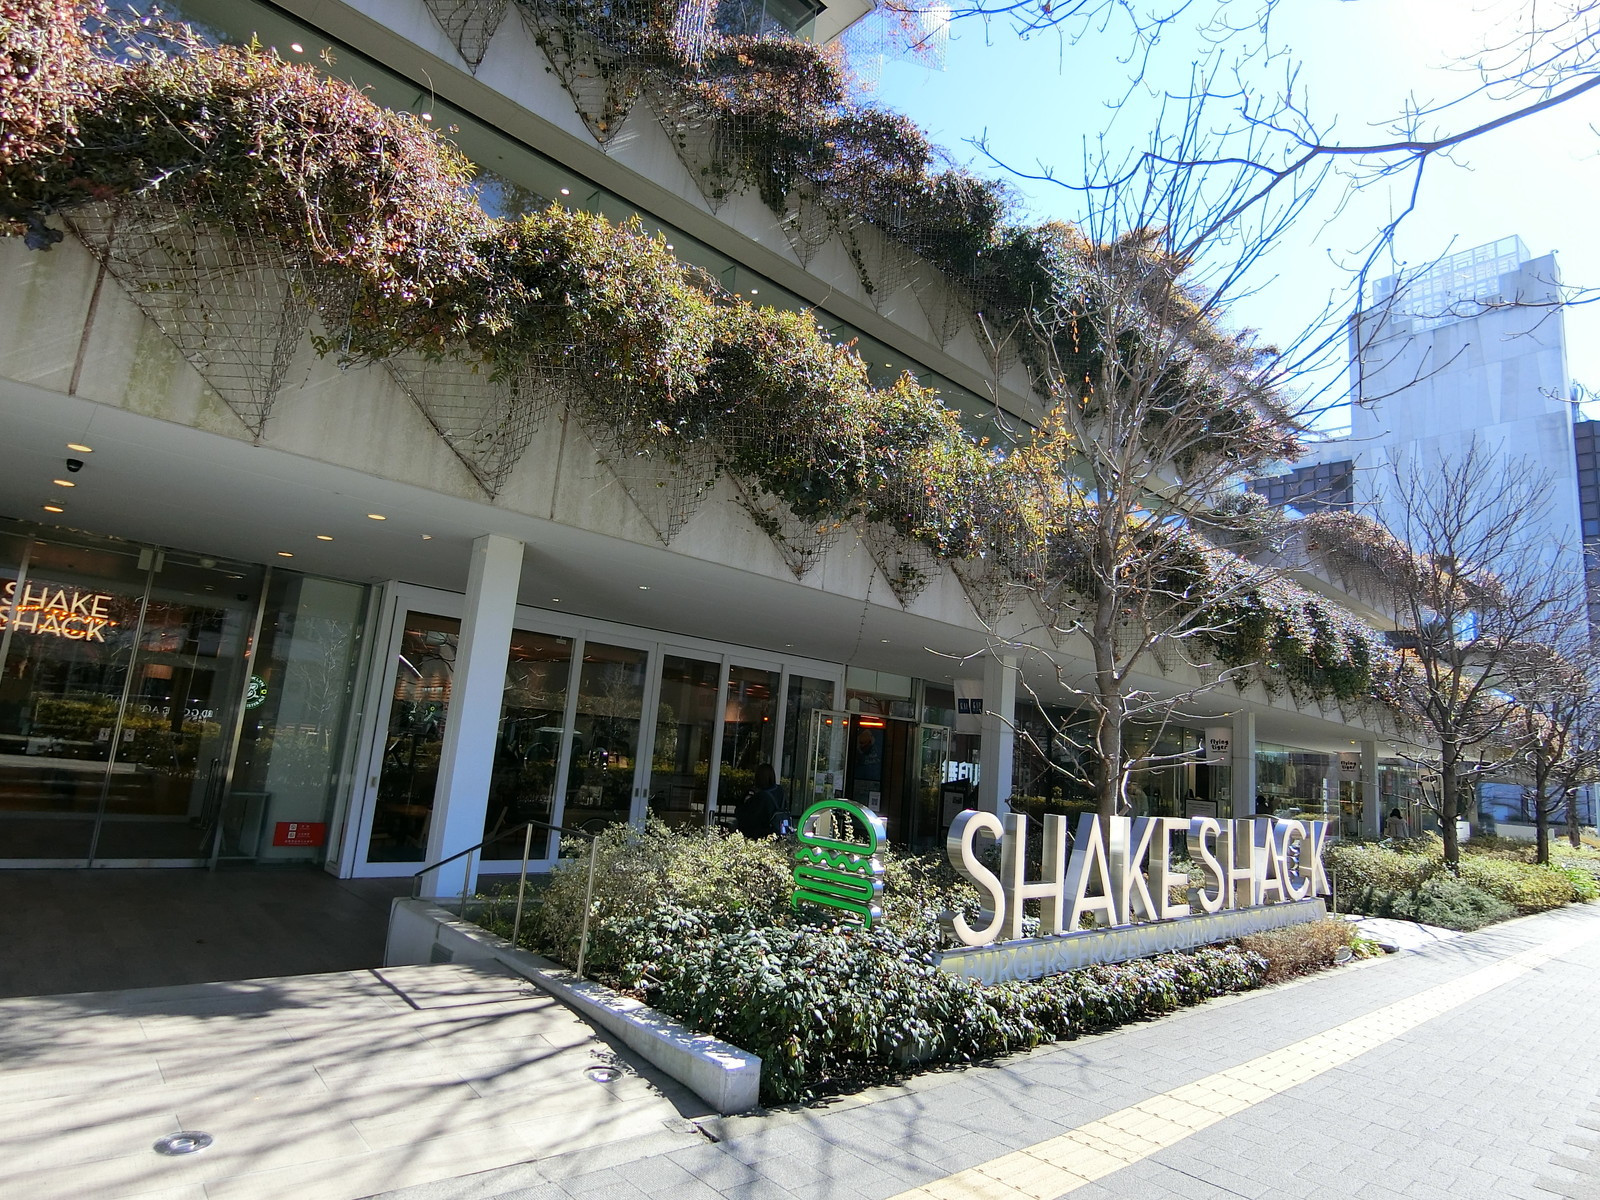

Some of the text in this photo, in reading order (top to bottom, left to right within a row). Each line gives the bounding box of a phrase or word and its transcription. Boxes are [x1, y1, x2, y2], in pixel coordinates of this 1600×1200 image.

[1, 582, 112, 619] SHAKE
[1210, 738, 1229, 746] flying
[947, 809, 1331, 947] SHAKE SHACK
[963, 941, 1069, 986] BURGERS
[1078, 928, 1147, 968] FROZEN
[1155, 916, 1219, 951] CUSTARD
